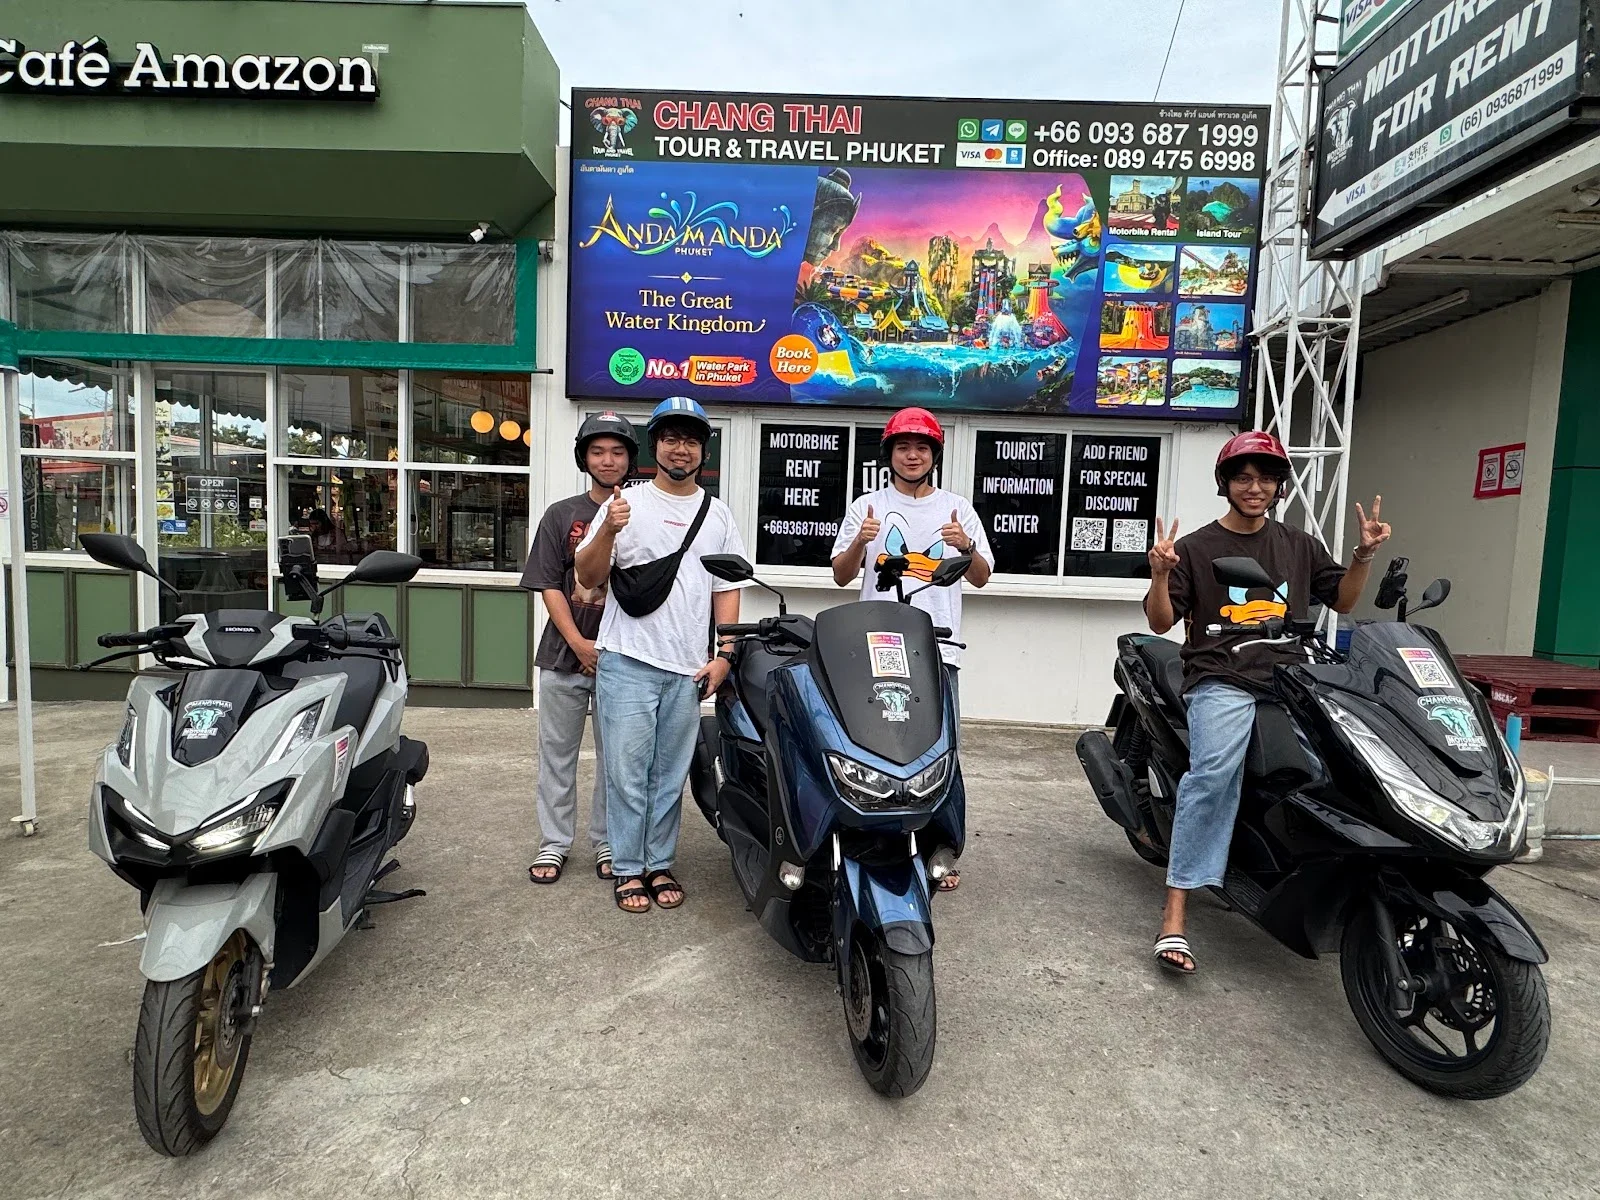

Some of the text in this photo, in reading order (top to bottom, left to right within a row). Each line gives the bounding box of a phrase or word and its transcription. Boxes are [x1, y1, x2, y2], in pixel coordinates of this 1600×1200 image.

[1363, 0, 1496, 104] MOTOR
[123, 42, 375, 93] Amazon
[1369, 0, 1553, 152] FOR RENT
[585, 97, 642, 110] CHANG THAI
[1460, 57, 1563, 137] (66) 0936871999
[653, 100, 862, 135] CHANG THAI
[1034, 121, 1258, 147] +66 093 687 1999
[592, 146, 605, 154] TOUR
[654, 135, 945, 164] TOUR & TRAVEL PHUKET
[960, 150, 981, 159] VISA
[1032, 148, 1098, 168] Office:
[1103, 149, 1145, 170] 089
[1152, 149, 1193, 170] 475
[1200, 150, 1256, 172] 6998
[1346, 183, 1366, 205] VISA
[579, 194, 782, 250] ANDAMANDA
[1109, 227, 1178, 238] Motorbike Rental
[1196, 229, 1242, 239] Island Tour
[674, 247, 713, 257] PHUKET
[639, 289, 733, 310] The Great
[605, 311, 766, 334] Water Kingdom
[647, 359, 690, 378] No.1
[696, 361, 751, 373] Water Park
[775, 346, 812, 374] Book Here
[706, 372, 743, 382] Phuket
[770, 432, 839, 451] MOTORBIKE
[995, 441, 1045, 461] TOURIST
[1083, 445, 1148, 461] ADD FRIEND
[785, 459, 821, 478] RENT
[200, 479, 224, 487] OPEN
[983, 477, 1054, 495] INFORMATION
[1080, 470, 1148, 487] FOR SPECIAL
[784, 487, 820, 506] HERE
[1085, 496, 1139, 512] DISCOUNT
[763, 520, 838, 537] +66936871999
[993, 514, 1039, 533] CENTER
[1420, 697, 1450, 706] CHANG
